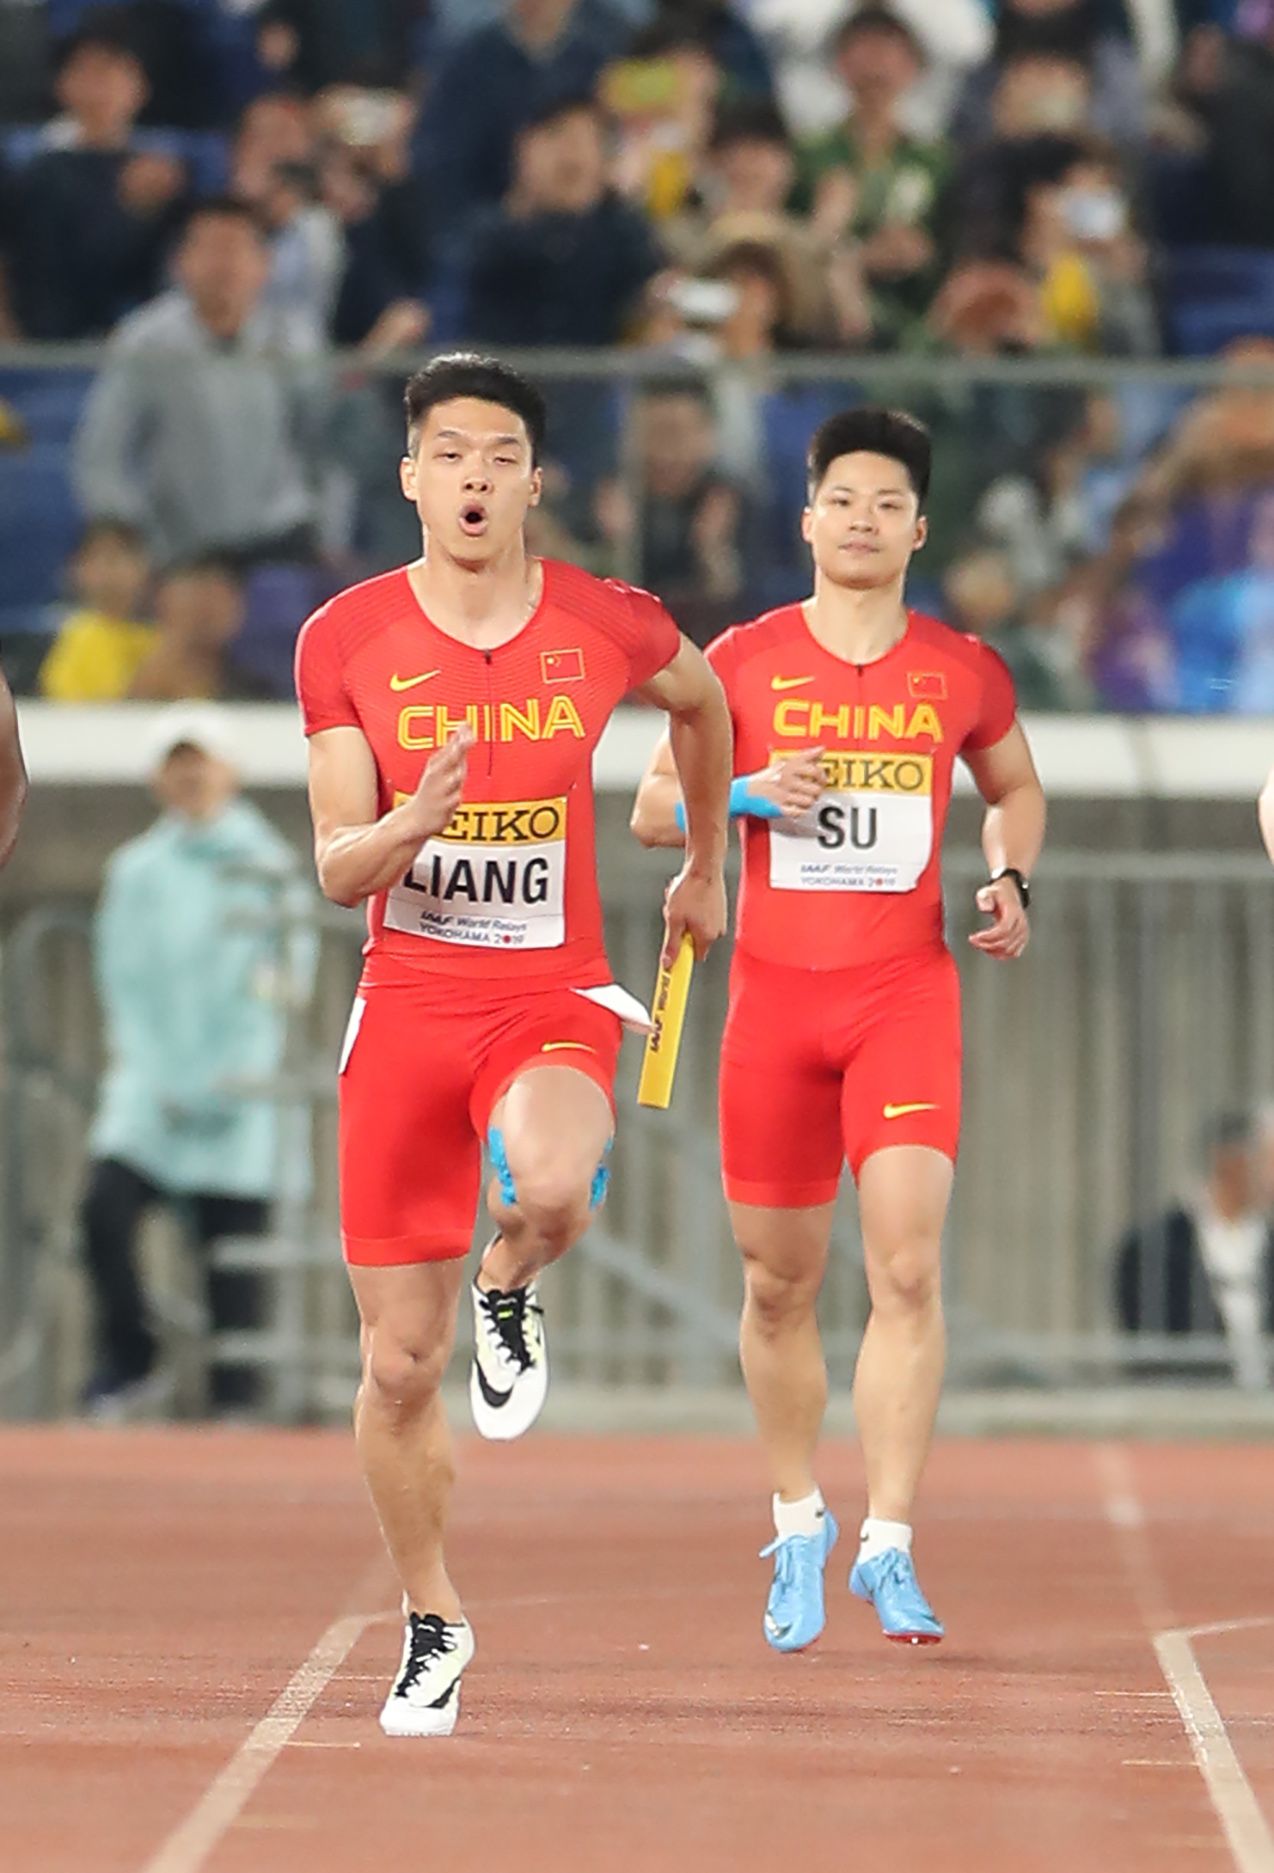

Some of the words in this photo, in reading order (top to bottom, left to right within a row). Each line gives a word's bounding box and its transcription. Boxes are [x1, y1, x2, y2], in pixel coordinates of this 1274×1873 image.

[398, 695, 587, 750] CHINA
[773, 698, 944, 743] CHINA
[818, 758, 924, 791] EIKO
[434, 806, 560, 842] EIKO
[818, 806, 877, 850] SU
[420, 922, 490, 942] YOKOHAMA
[457, 917, 492, 928] World
[492, 919, 527, 932] Relays
